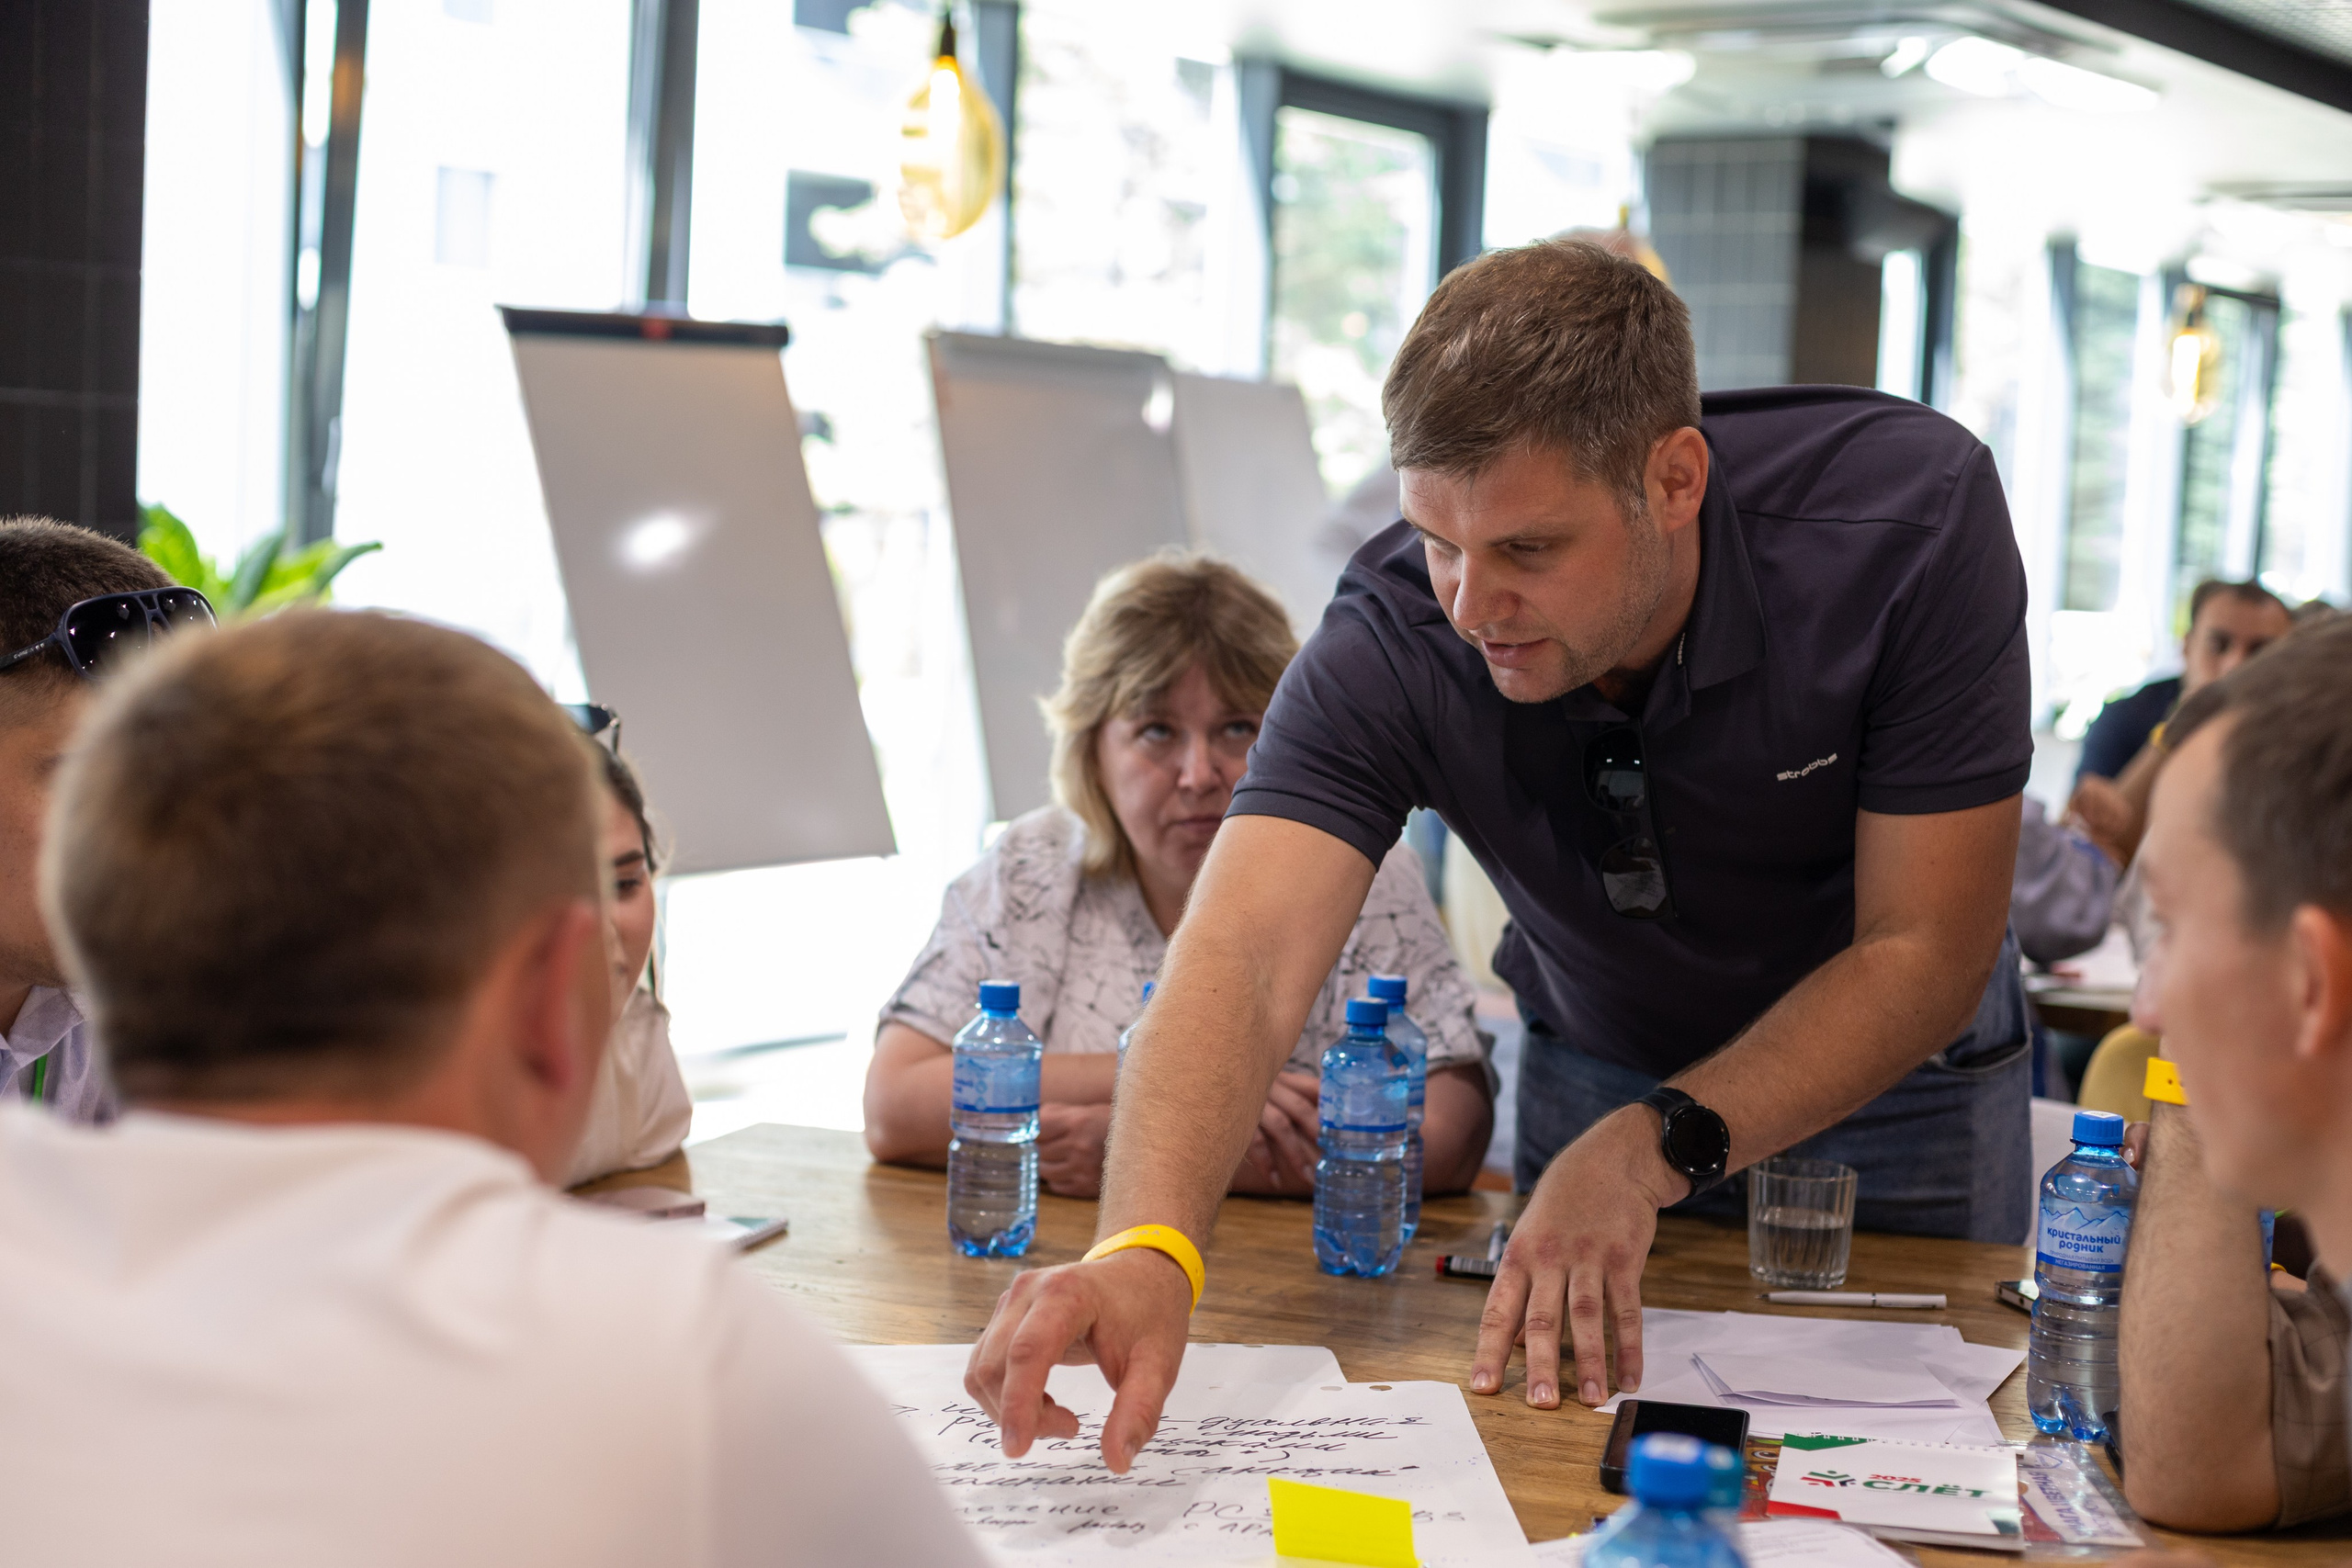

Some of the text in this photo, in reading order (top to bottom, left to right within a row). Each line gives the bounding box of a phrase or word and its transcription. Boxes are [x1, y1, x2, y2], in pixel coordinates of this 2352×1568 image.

[1776, 752, 1838, 781] strobbs
[2047, 1227, 2121, 1245] кристальный
[2059, 1240, 2104, 1253] родник
[1868, 1473, 1922, 1483] 2025
[1862, 1480, 1993, 1498] СЛЁТ
